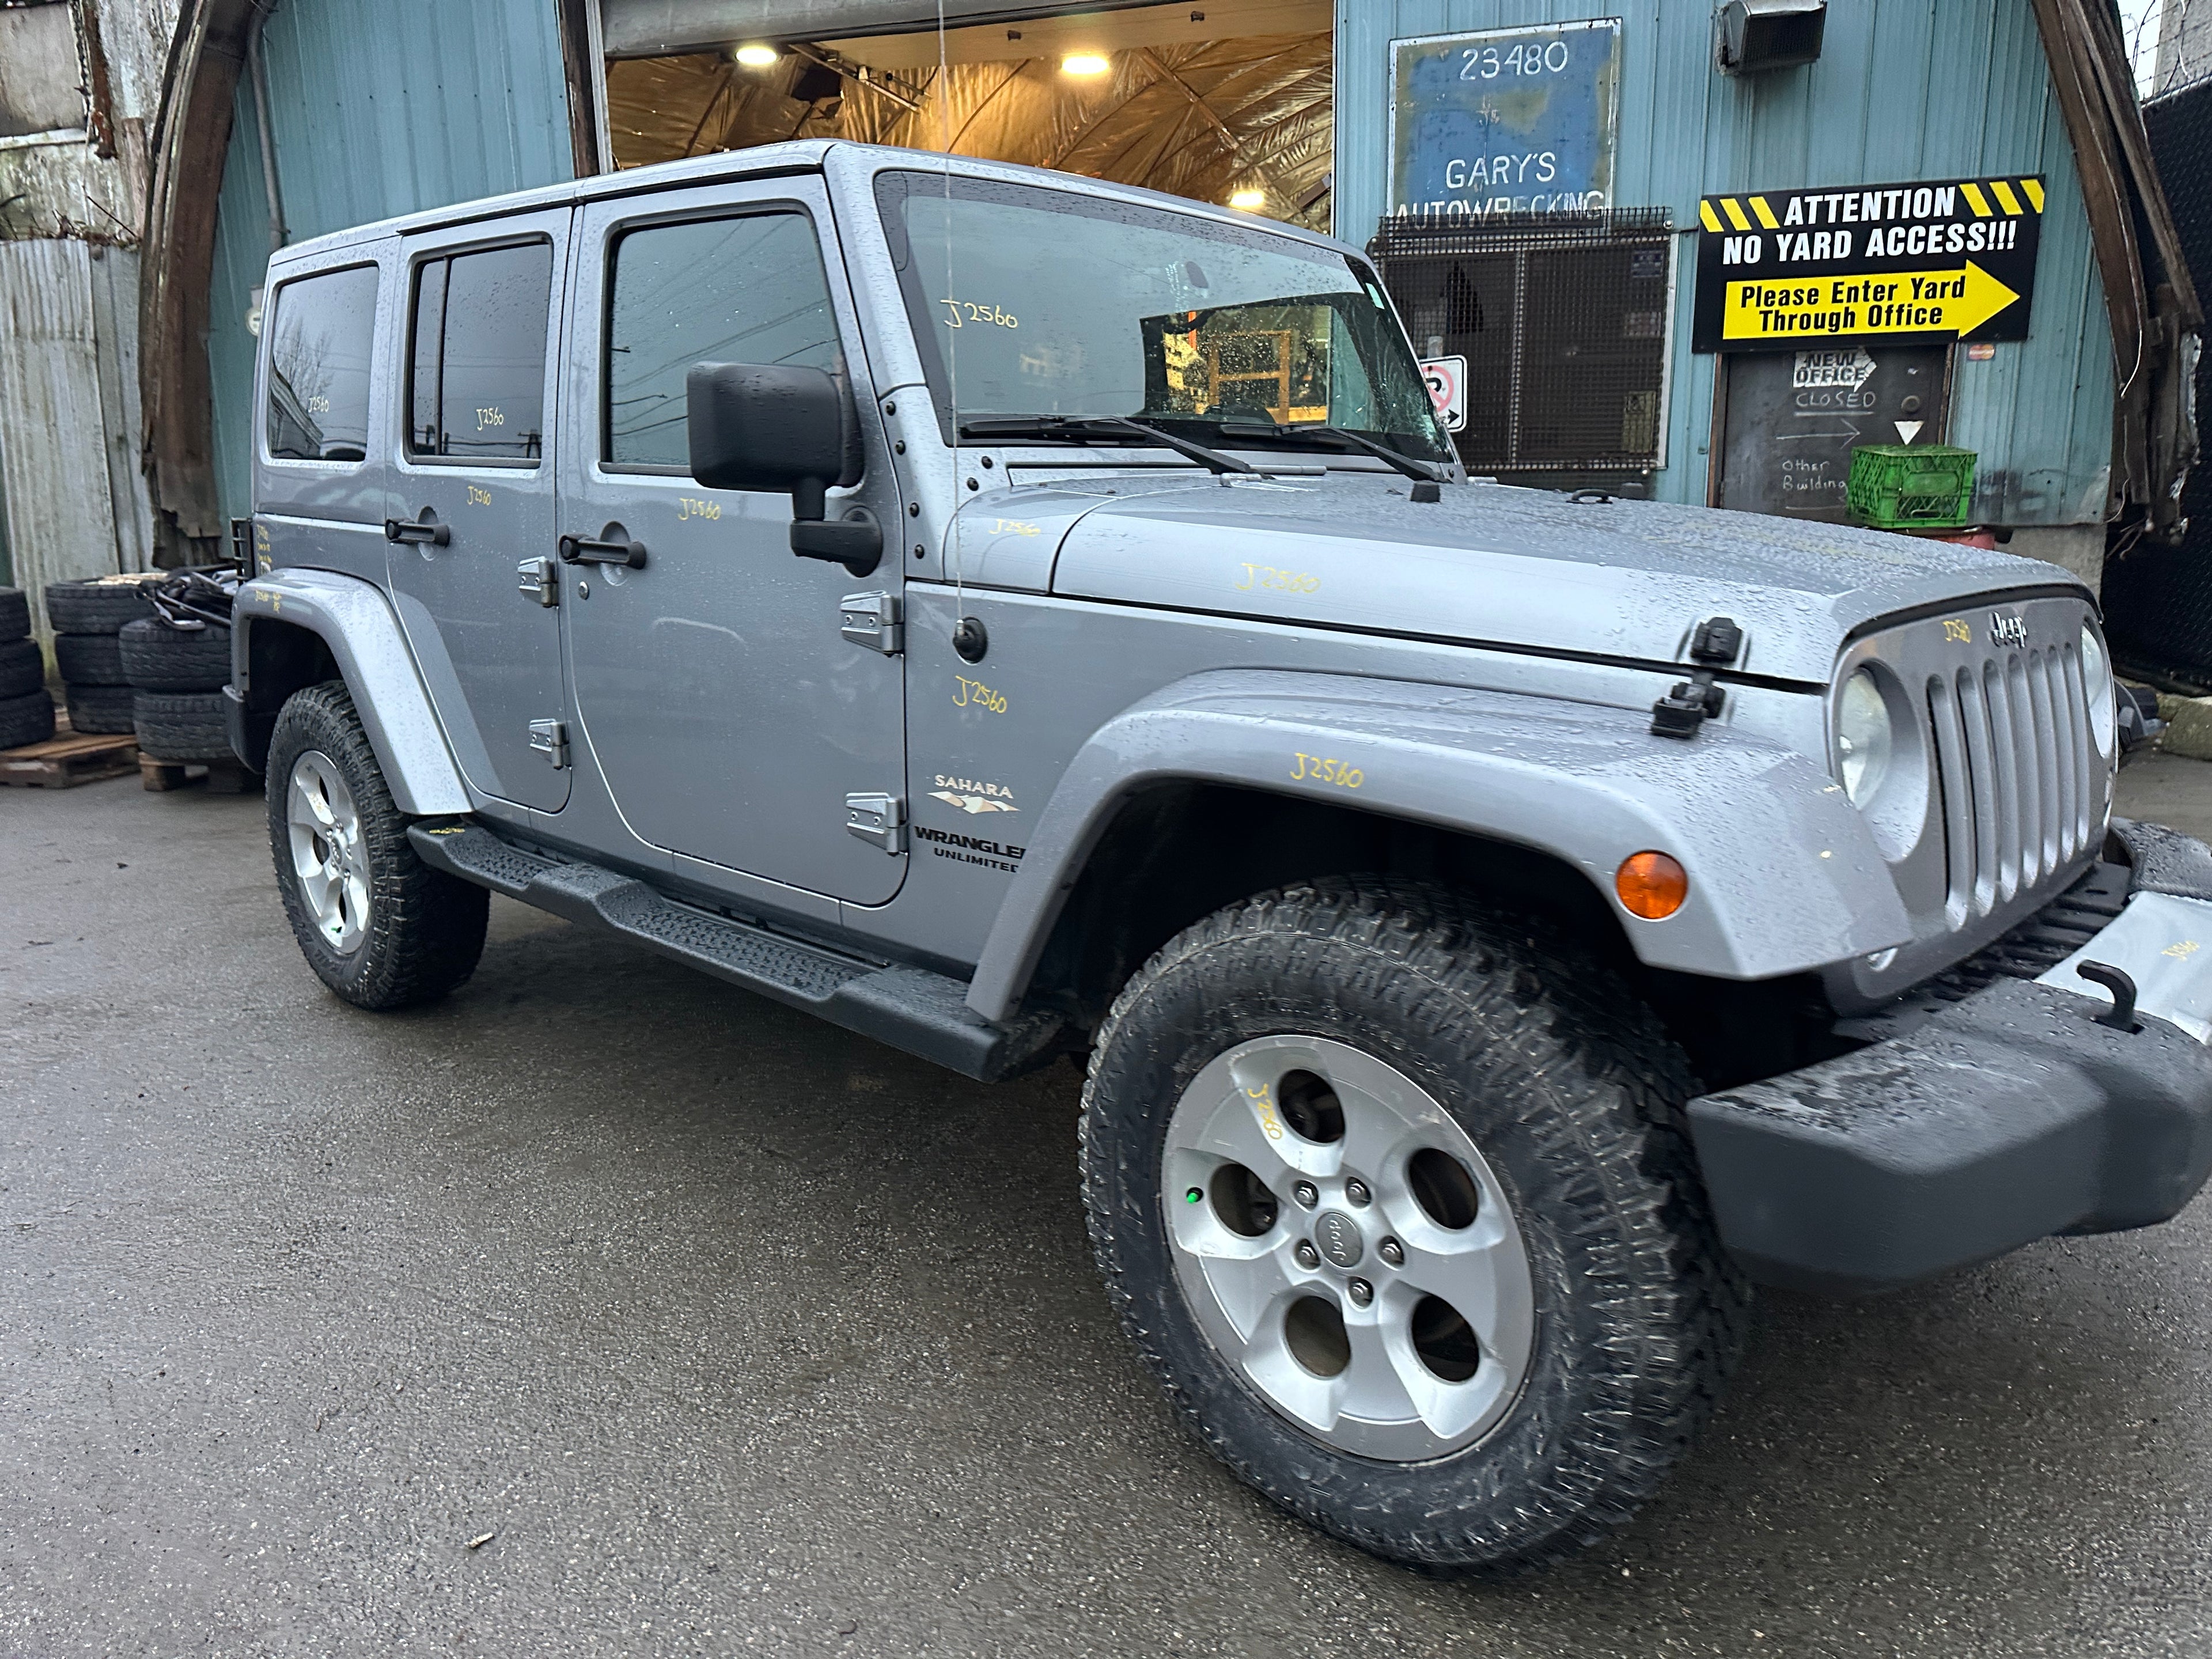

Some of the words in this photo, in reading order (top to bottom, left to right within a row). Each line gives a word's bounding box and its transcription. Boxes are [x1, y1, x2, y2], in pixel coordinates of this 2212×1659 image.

[1460, 41, 1569, 80] 23480
[1446, 151, 1556, 189] GARY'S
[1783, 187, 1956, 226] ATTENTION
[1722, 236, 1762, 265] NO
[1777, 229, 1853, 262] YARD
[1865, 220, 2017, 257] ACCESS!!!
[1741, 285, 1819, 308] Please
[1831, 280, 1898, 303] Enter
[1911, 275, 1966, 300] Yard
[940, 298, 1019, 329] J2560
[1759, 309, 1855, 332] Through
[1868, 304, 1943, 325] Office
[1808, 353, 1857, 367] NEW
[1796, 367, 1866, 384] OFFICE
[308, 395, 329, 413] J2560
[1796, 391, 1876, 408] CLOSED
[476, 406, 505, 431] J2560
[1782, 459, 1831, 471] Other
[467, 485, 492, 506] J2560
[1783, 475, 1849, 498] Building
[677, 498, 721, 520] J2560
[1235, 562, 1321, 593] J2560
[1991, 612, 2027, 648] Jeep
[952, 675, 1007, 713] J2560
[1290, 752, 1364, 787] J2560
[934, 774, 1014, 799] SAHARA
[914, 825, 1027, 859] WRANGLE
